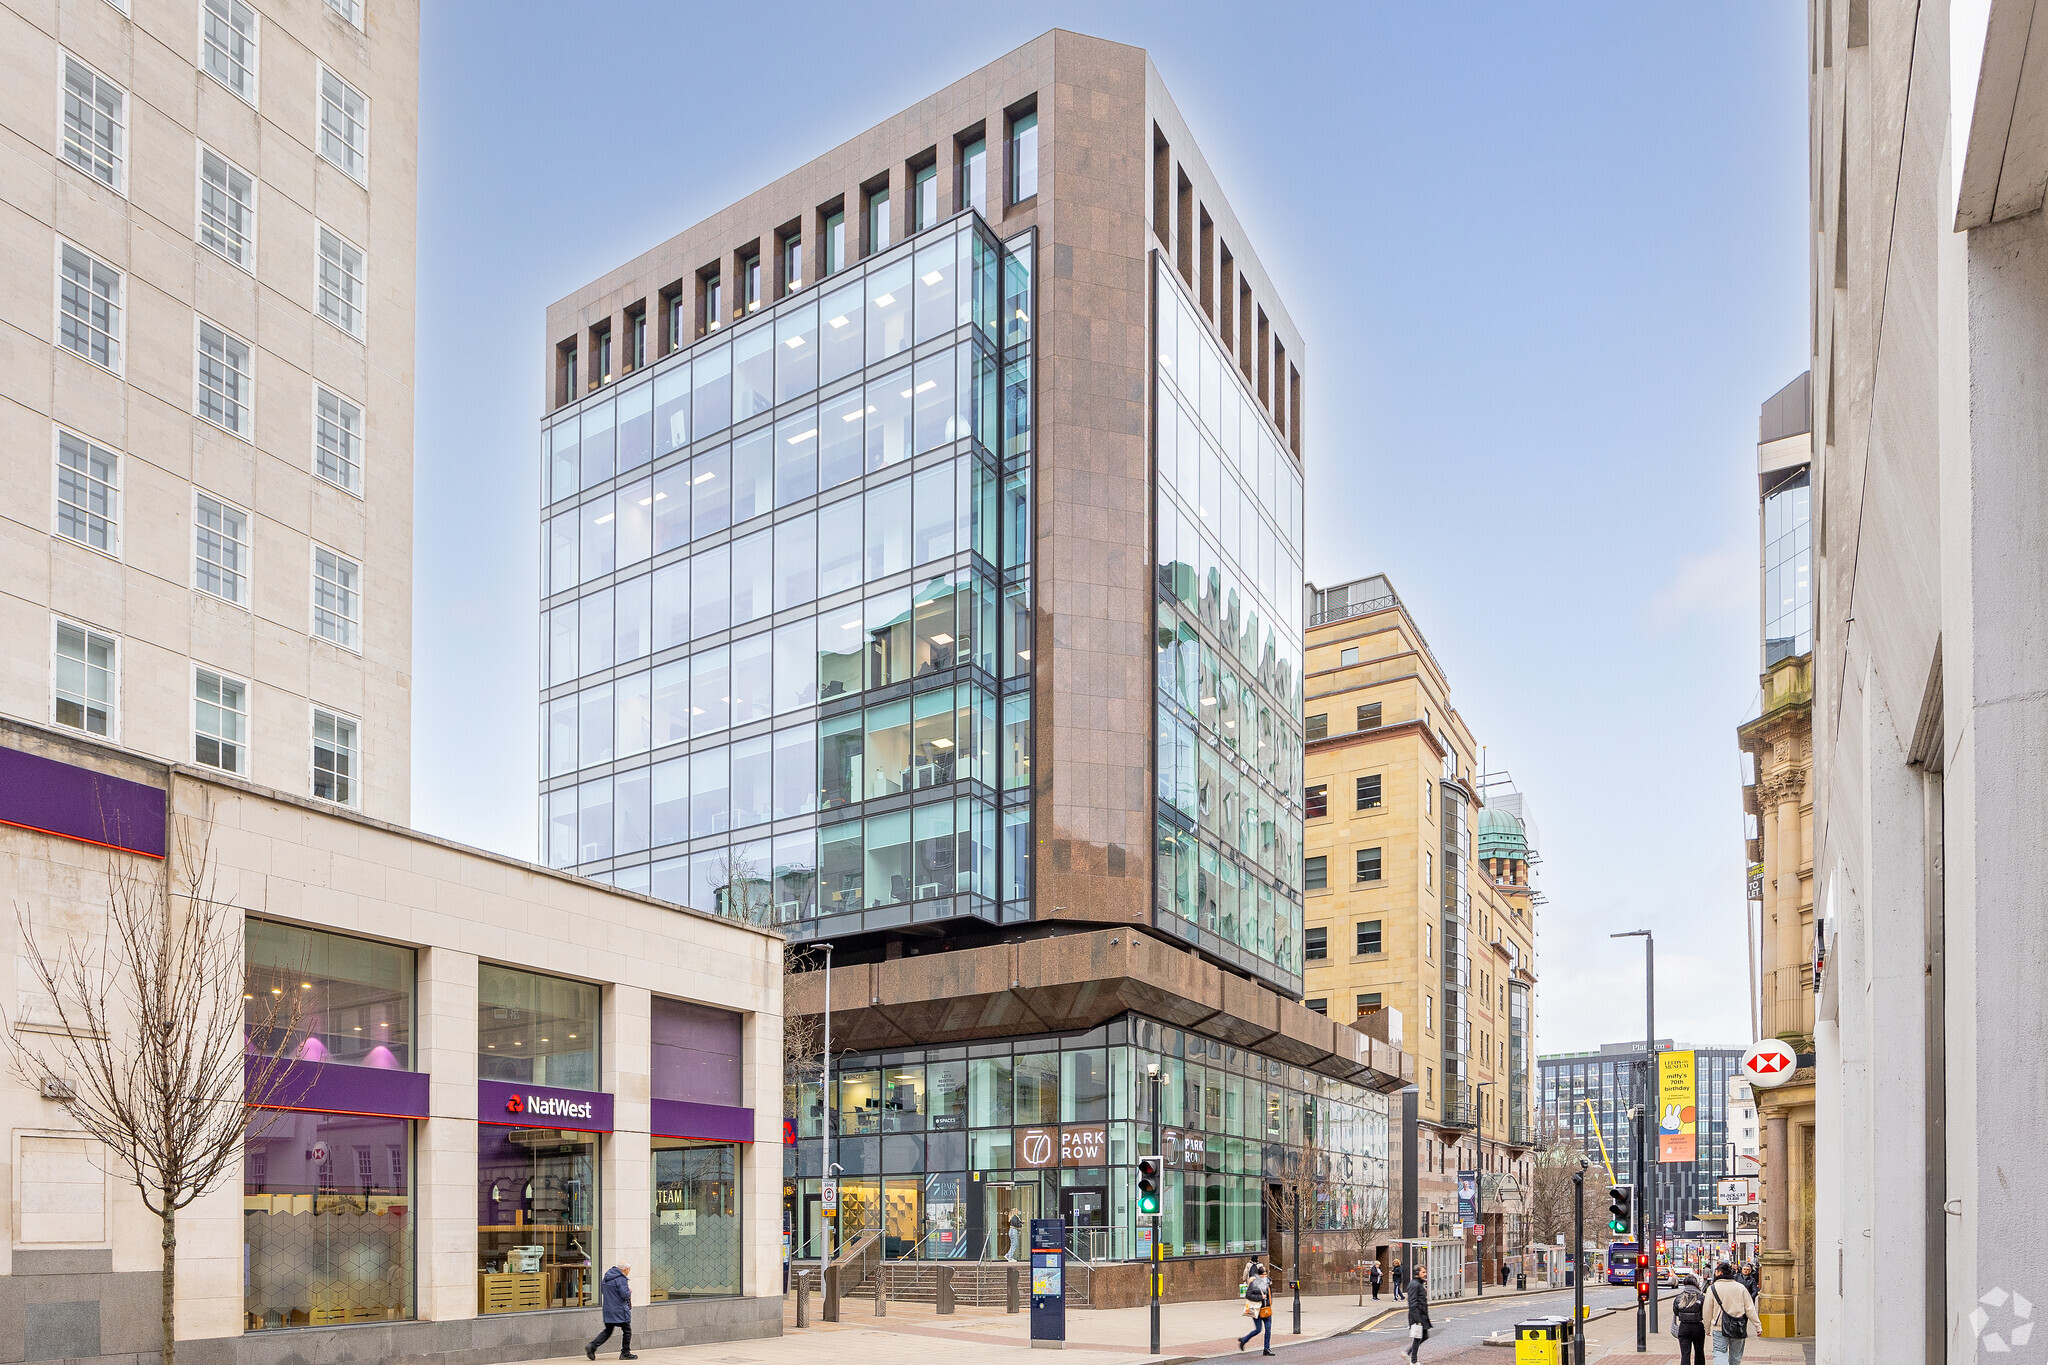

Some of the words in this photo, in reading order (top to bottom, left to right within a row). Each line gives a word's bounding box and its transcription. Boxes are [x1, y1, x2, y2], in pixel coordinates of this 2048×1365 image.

[1749, 881, 1758, 891] TO
[1748, 887, 1760, 899] LET
[528, 1096, 592, 1118] NatWest
[1062, 1131, 1104, 1145] PARK
[1185, 1138, 1204, 1151] PARK
[1062, 1146, 1098, 1159] ROW
[933, 1183, 940, 1195] 7
[941, 1182, 958, 1190] PARK
